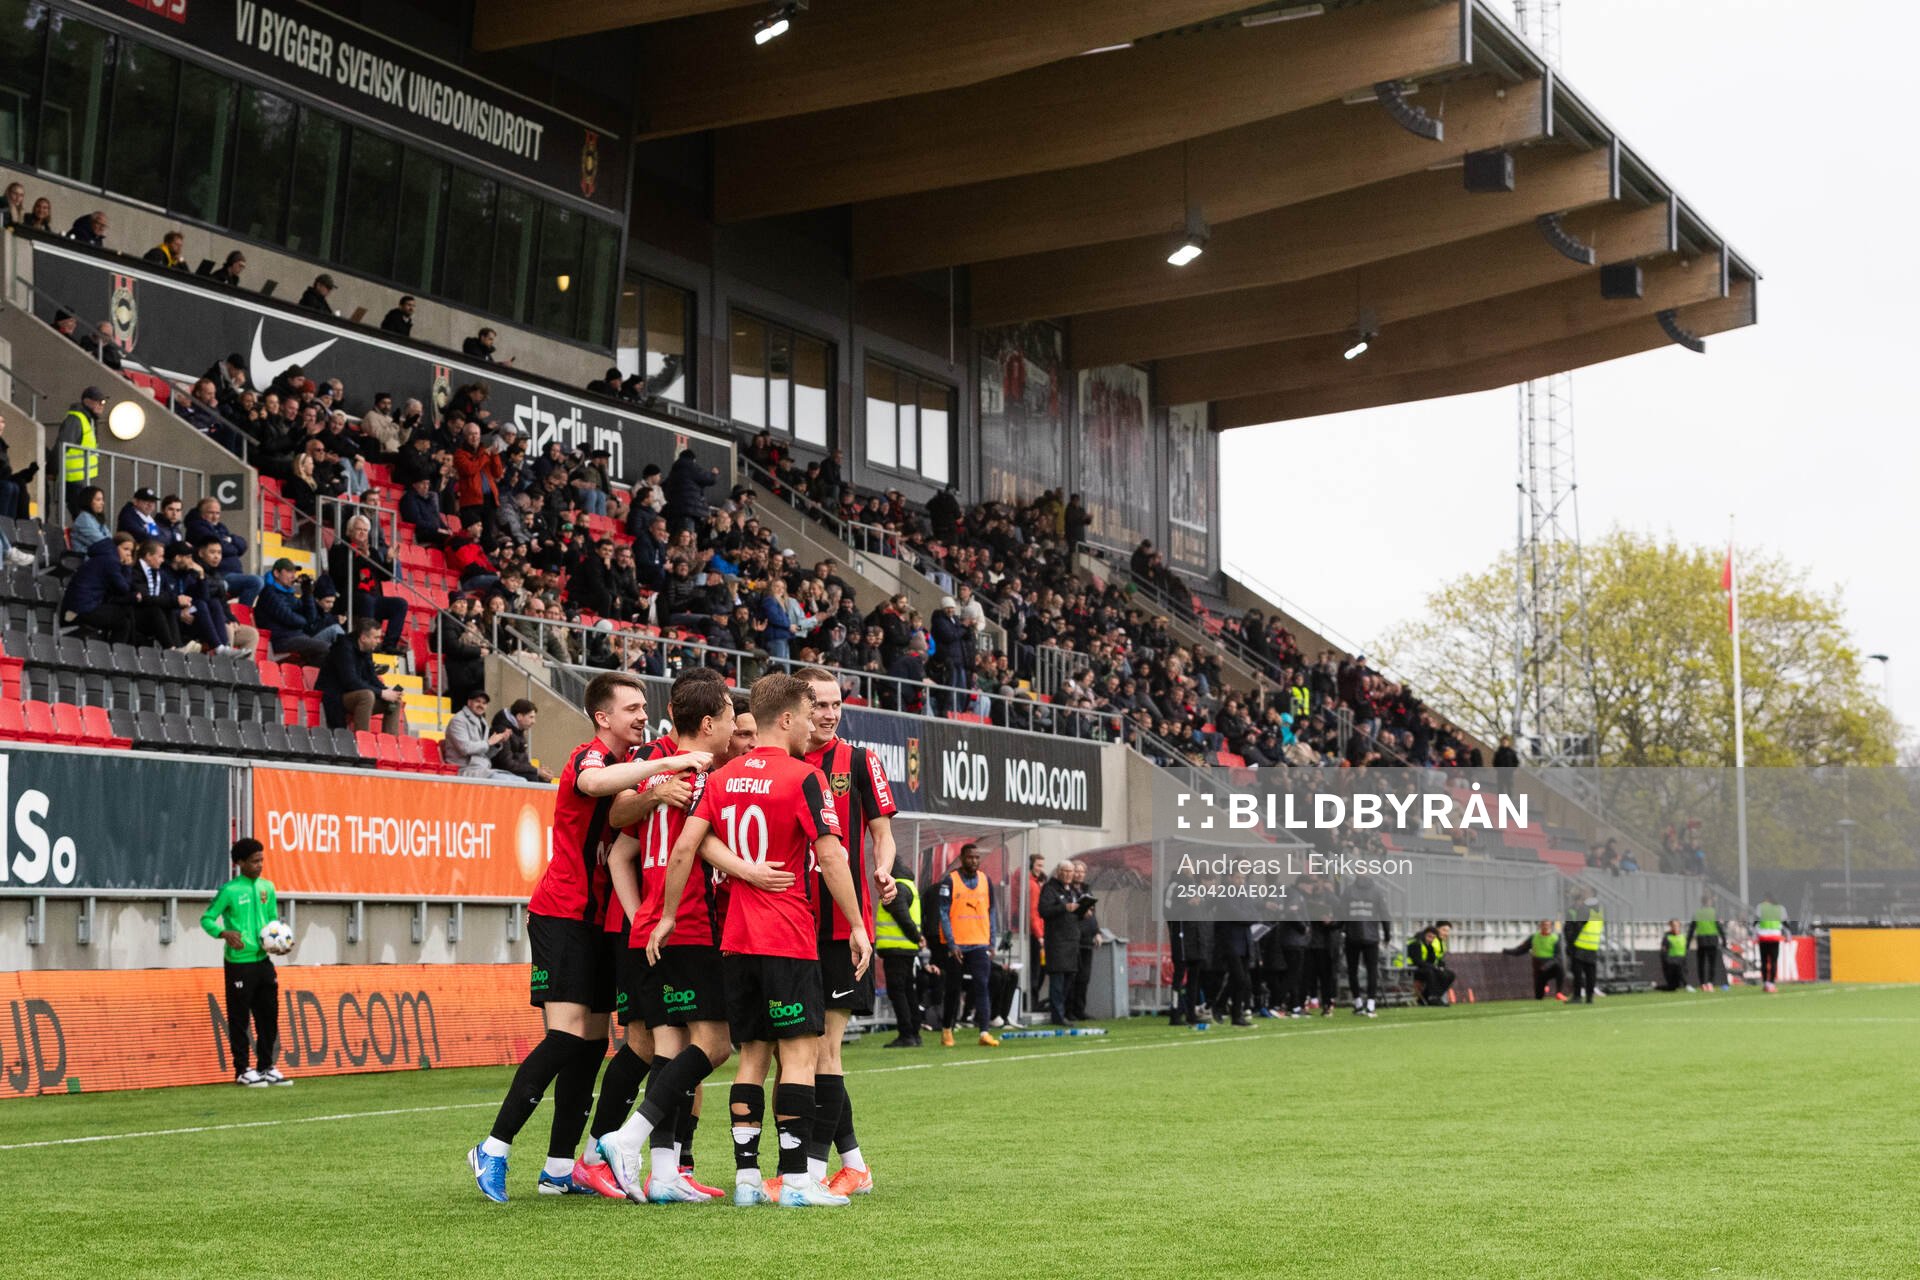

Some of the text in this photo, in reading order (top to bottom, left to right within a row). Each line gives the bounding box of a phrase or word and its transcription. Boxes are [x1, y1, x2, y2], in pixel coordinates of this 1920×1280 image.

[236, 0, 544, 162] VI BYGGER SVENSK UNGDOMSIDROTT
[217, 480, 237, 504] C
[725, 777, 774, 795] ODEFALK
[868, 755, 893, 808] stadium
[943, 739, 990, 802] NÖJD
[1005, 757, 1088, 812] NOJD.com
[268, 810, 341, 853] POWER
[345, 815, 440, 858] THROUGH
[445, 820, 496, 859] LIGHT
[720, 803, 769, 866] 10
[769, 1002, 804, 1019] coop
[0, 998, 67, 1093] JD
